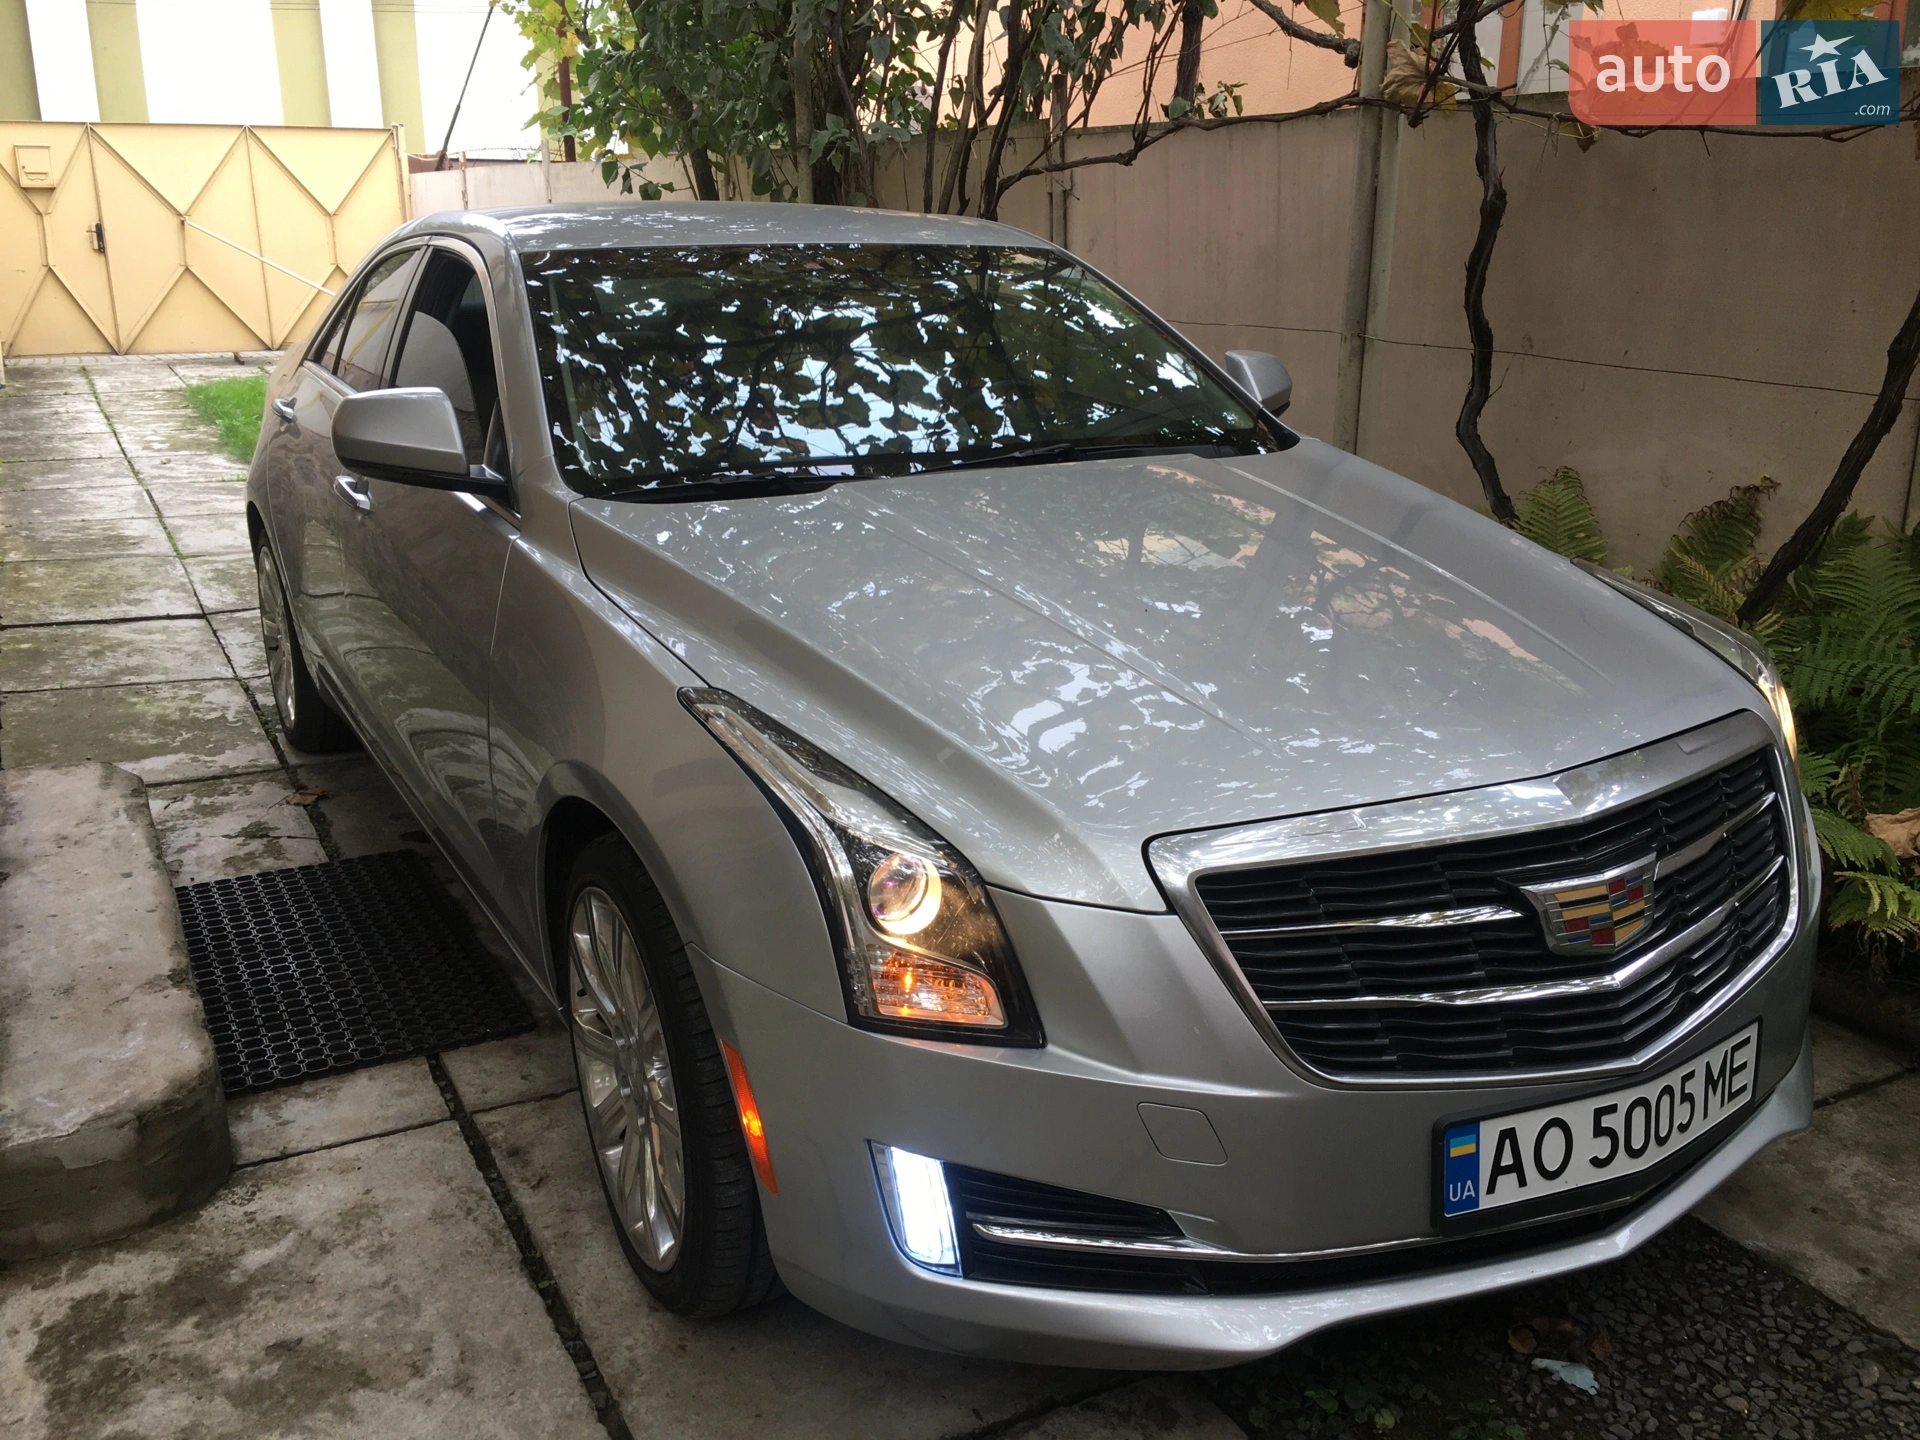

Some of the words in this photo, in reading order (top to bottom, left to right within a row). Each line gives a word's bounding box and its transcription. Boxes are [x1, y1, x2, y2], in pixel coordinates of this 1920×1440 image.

[1486, 1116, 1574, 1195] AO
[1589, 1069, 1696, 1169] 5005
[1702, 1035, 1751, 1120] ME
[1449, 1179, 1476, 1202] UA
